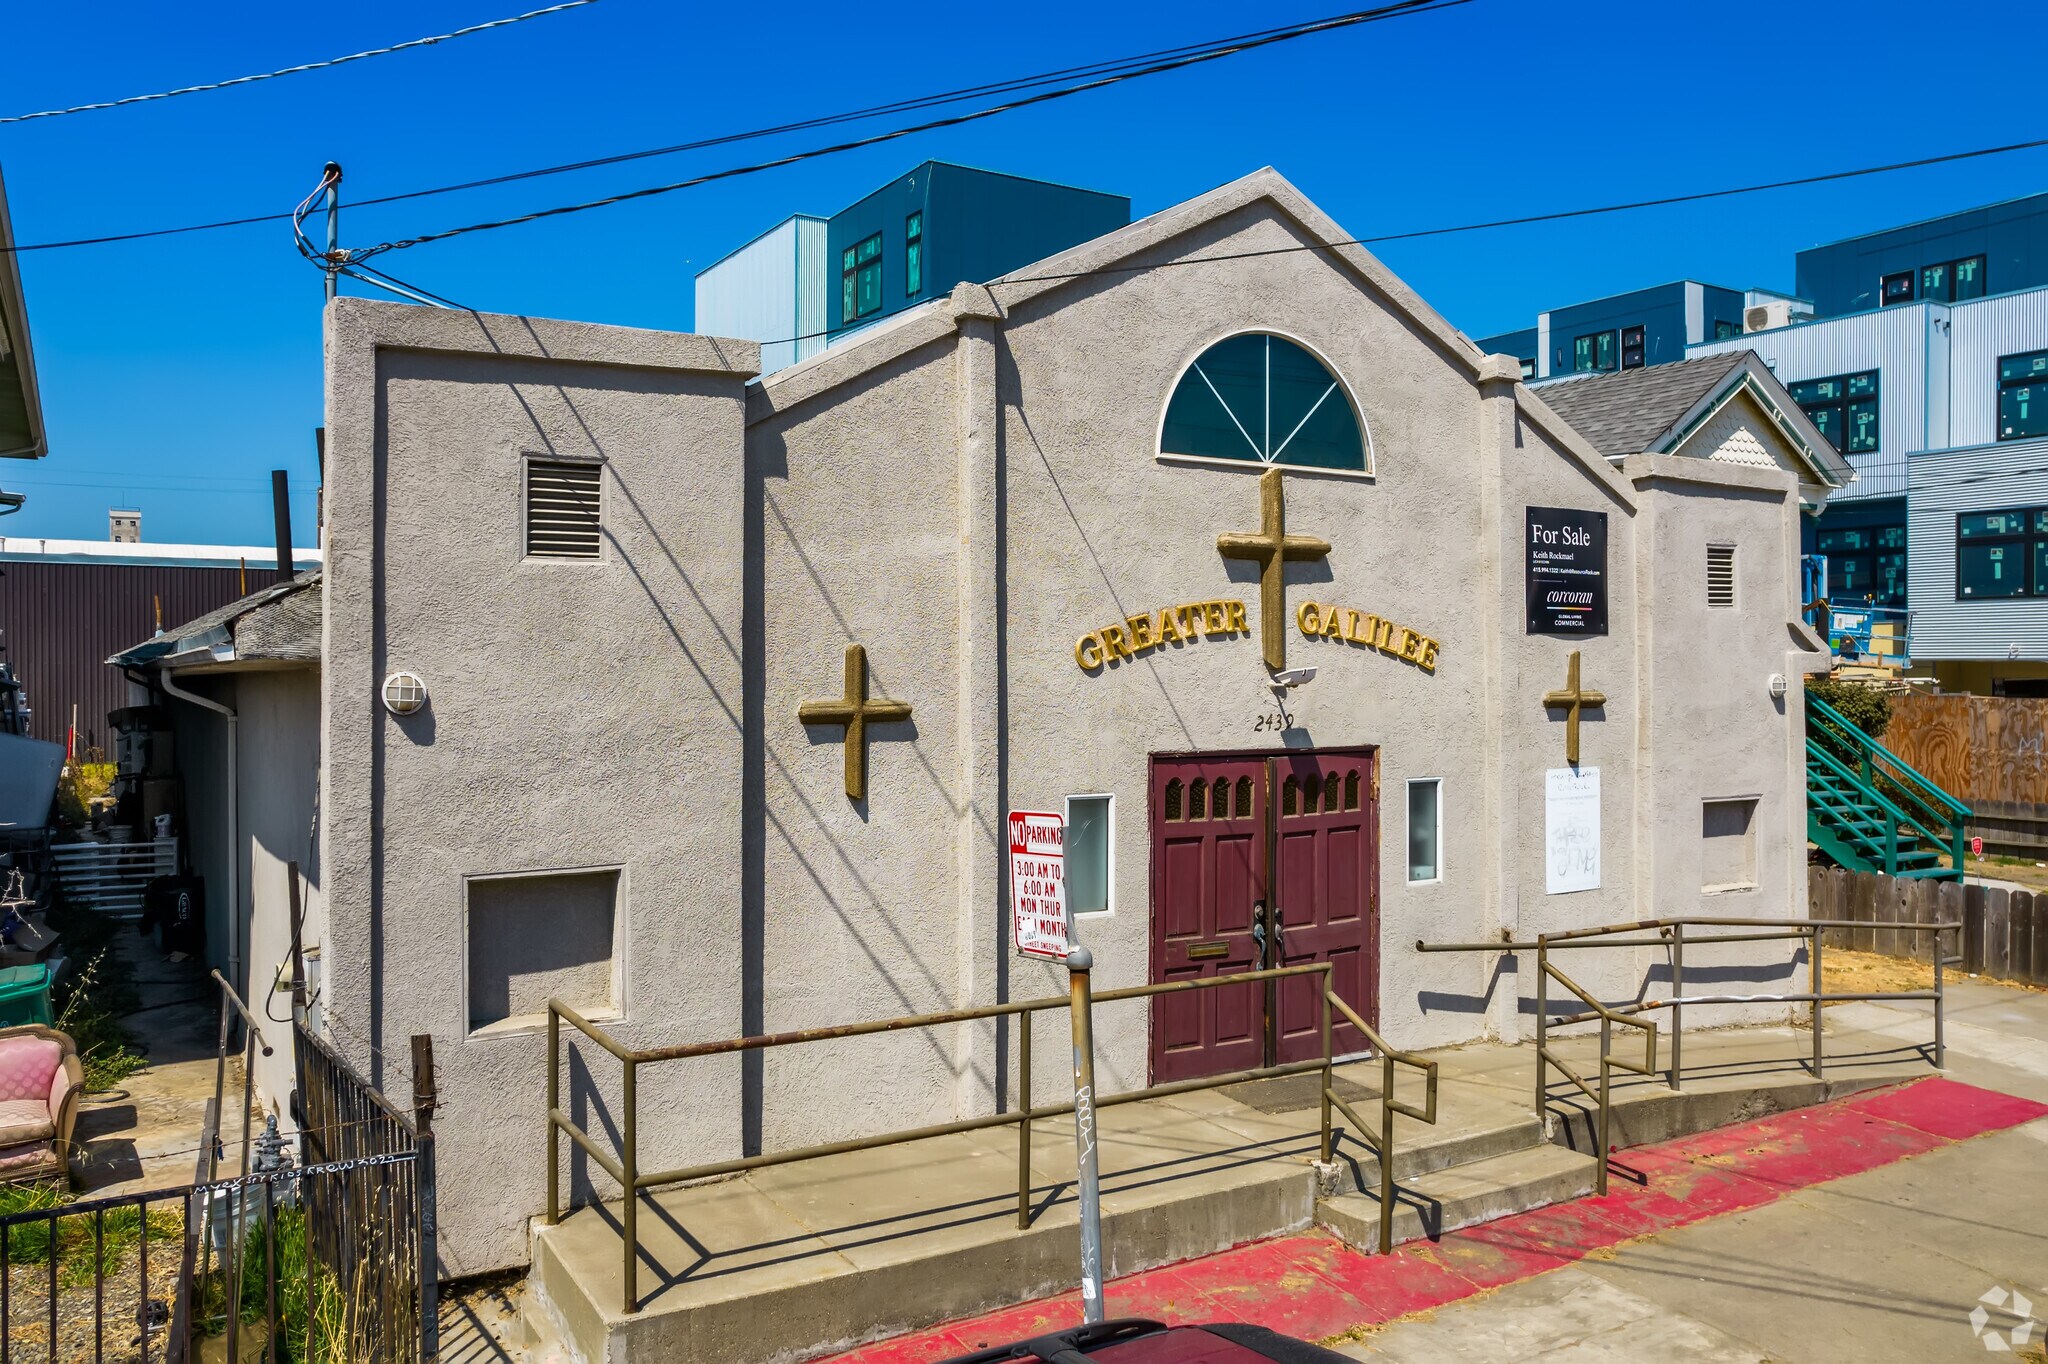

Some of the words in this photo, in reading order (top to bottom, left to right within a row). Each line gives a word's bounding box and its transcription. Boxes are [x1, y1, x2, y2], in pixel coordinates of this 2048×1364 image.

[1531, 524, 1558, 544] For
[1562, 525, 1591, 546] Sale
[1532, 551, 1548, 559] Keith
[1546, 590, 1593, 604] corcoran
[1074, 599, 1251, 670] GREATER
[1296, 601, 1441, 670] GALILEE
[1010, 820, 1026, 847] NO
[1026, 825, 1063, 846] PARKING
[1016, 860, 1035, 877] 3:00
[1037, 862, 1049, 879] AM
[1050, 863, 1061, 880] TO
[1023, 880, 1042, 897] 6:00
[1044, 881, 1056, 898] AM
[1020, 897, 1037, 914] MON
[1040, 899, 1061, 917] THUR
[1039, 919, 1067, 938] MONTH
